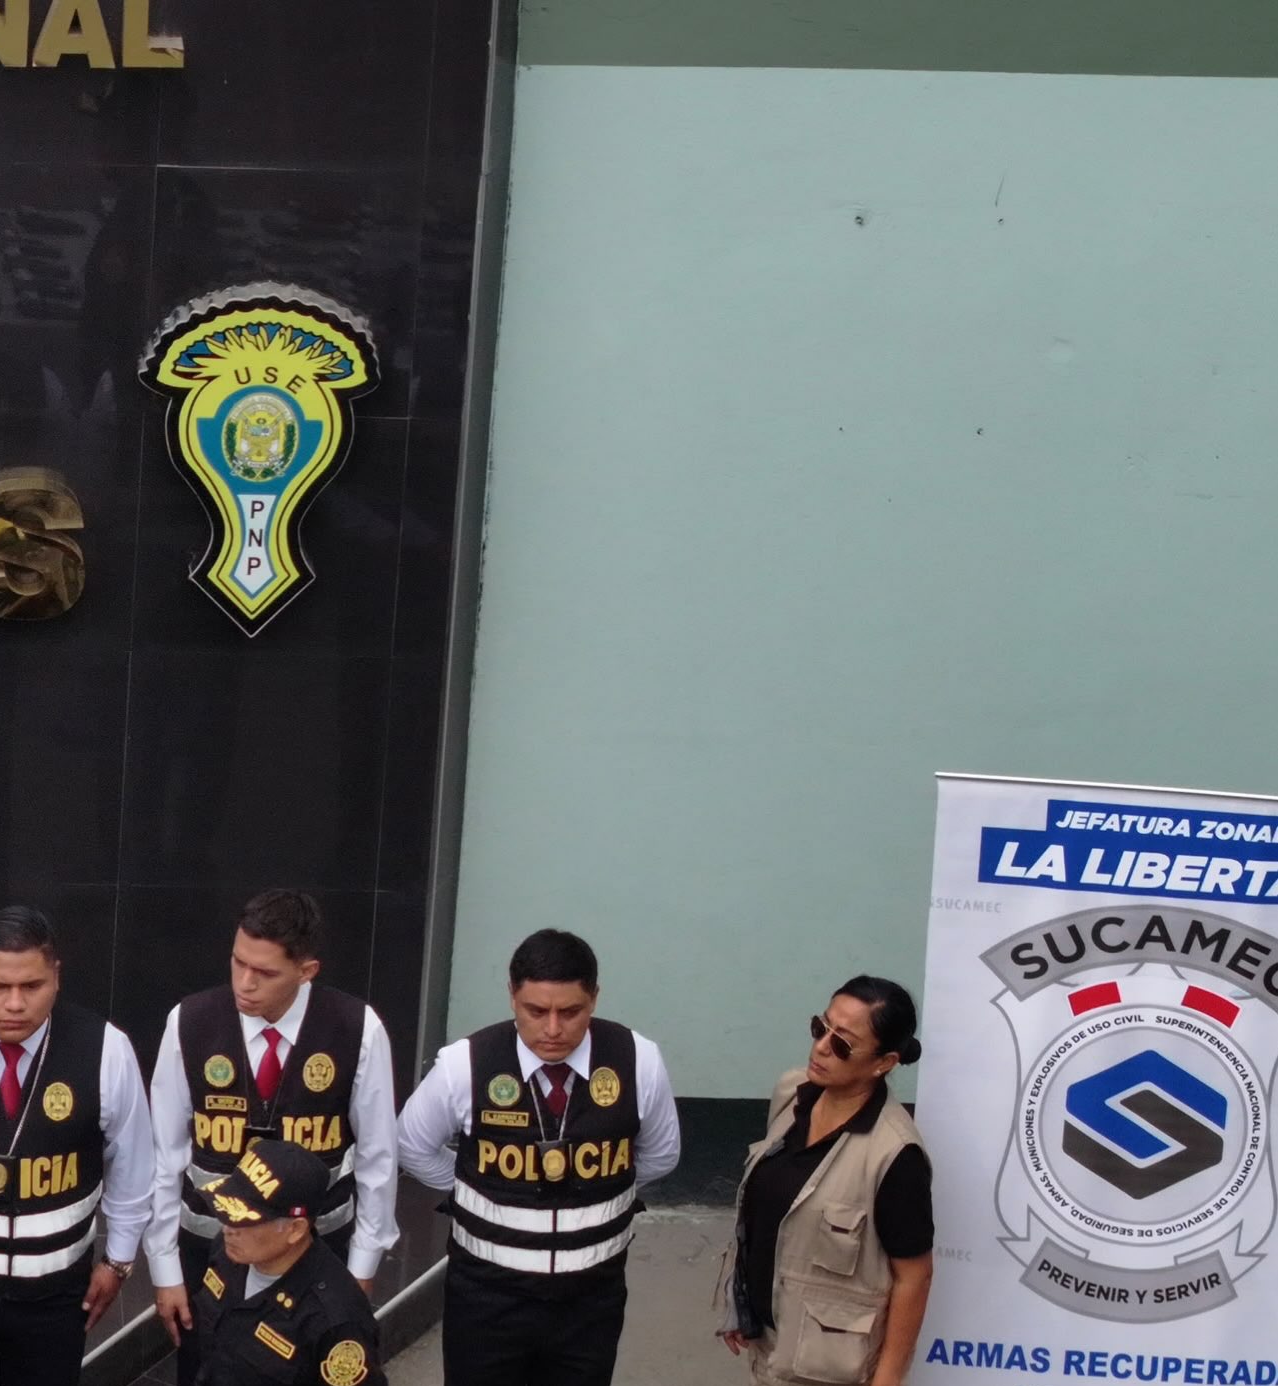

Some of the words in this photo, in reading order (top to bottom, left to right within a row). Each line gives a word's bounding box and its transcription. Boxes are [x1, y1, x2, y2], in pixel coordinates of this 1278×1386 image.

[234, 366, 307, 395] USE
[1054, 809, 1191, 839] JEFATURA
[994, 841, 1067, 883] LA
[935, 898, 1003, 913] SUCAMEC
[1087, 1020, 1112, 1036] USO
[1113, 1014, 1145, 1027] CIVIL
[1071, 1030, 1088, 1046] DE
[1154, 1014, 1250, 1082] SUPERINTENDENCIA
[1030, 1040, 1073, 1099] EXPLOSIVOS
[1243, 1079, 1262, 1134] NACIONAL
[1024, 1107, 1045, 1173] MUNICIONES
[1250, 1136, 1261, 1151] DE
[1224, 1151, 1257, 1199] CONTROL
[1212, 1197, 1229, 1213] DE
[1069, 1205, 1135, 1238] SEGURIDAD,
[1136, 1229, 1154, 1238] DE
[1155, 1207, 1215, 1237] SERVICIOS
[1037, 1258, 1130, 1304] PREVENIR
[1135, 1289, 1148, 1304] Y
[1153, 1272, 1222, 1304] SERVIR
[925, 1338, 1051, 1374] ARMAS
